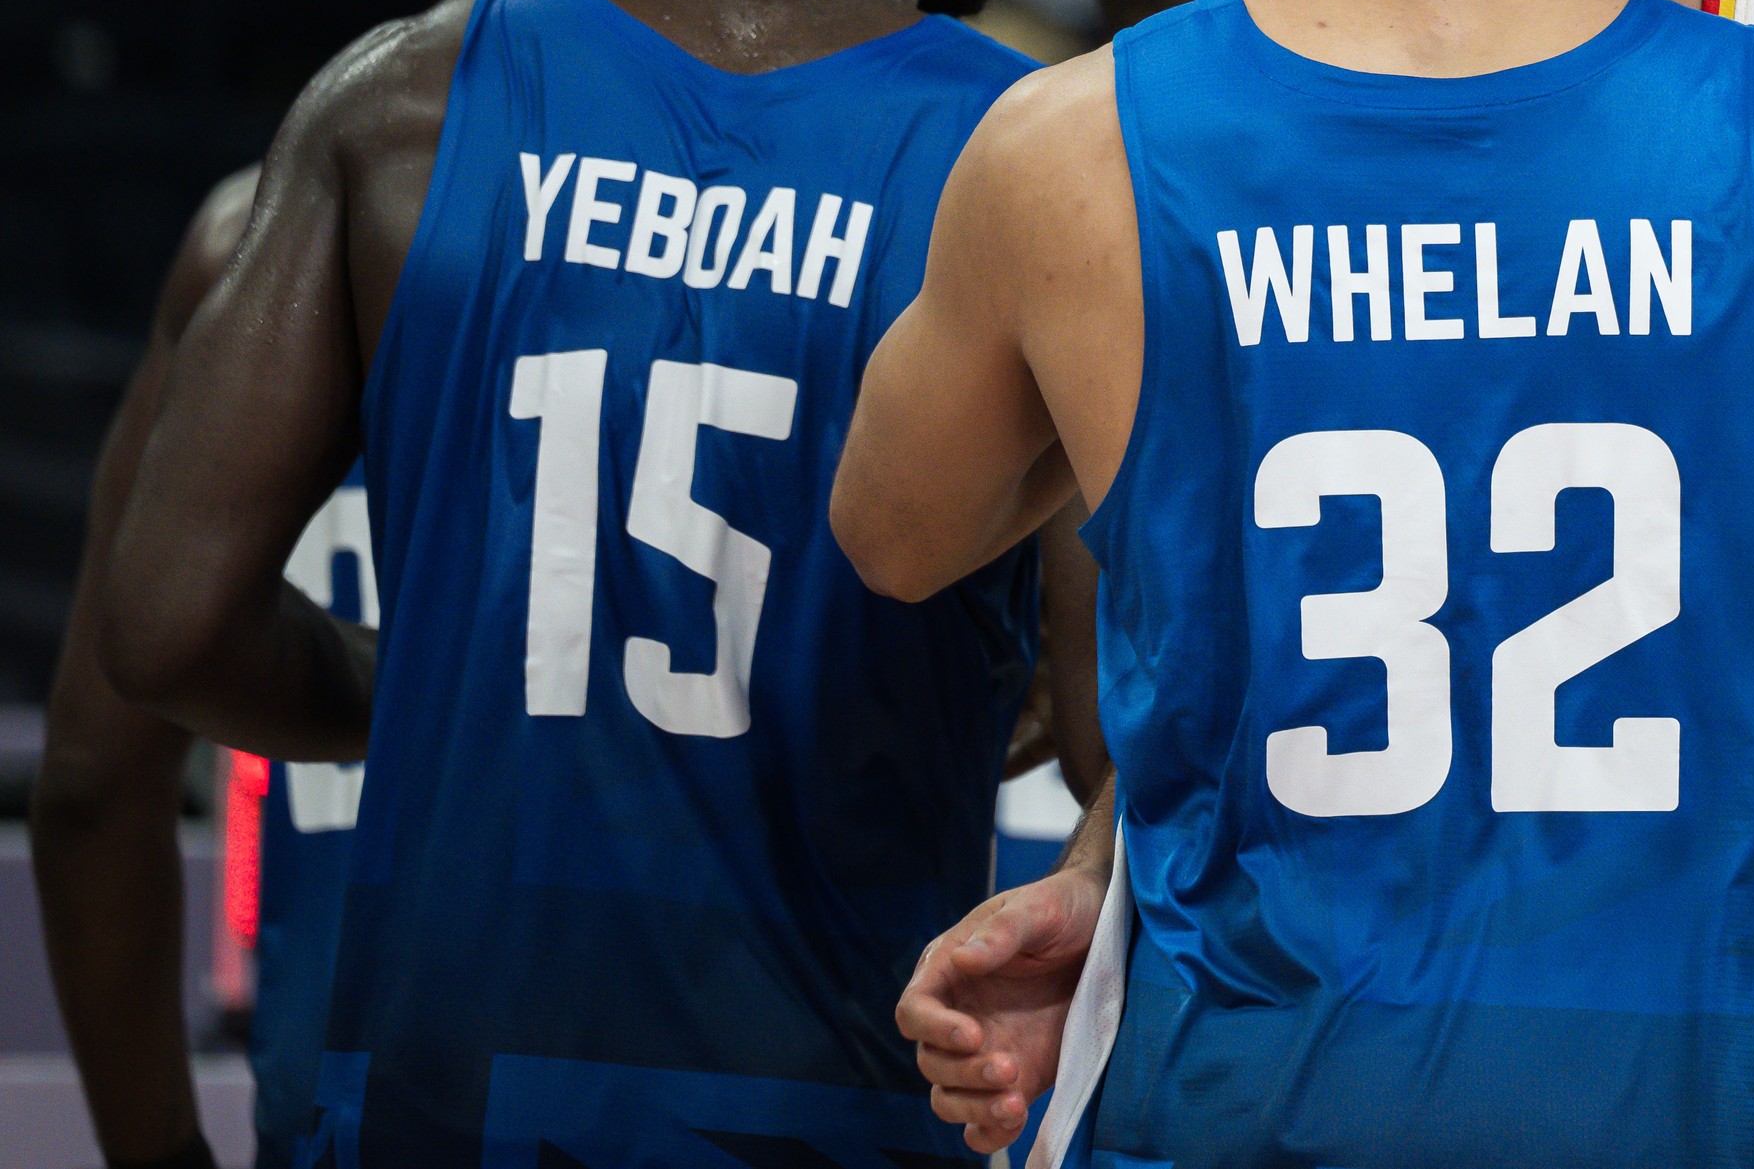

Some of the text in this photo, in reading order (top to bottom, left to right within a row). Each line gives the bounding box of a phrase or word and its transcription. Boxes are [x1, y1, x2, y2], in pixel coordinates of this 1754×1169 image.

[519, 152, 874, 308] YEBOAH
[1216, 219, 1693, 346] WHELAN
[508, 348, 799, 738] 15
[1254, 422, 1681, 818] 32
